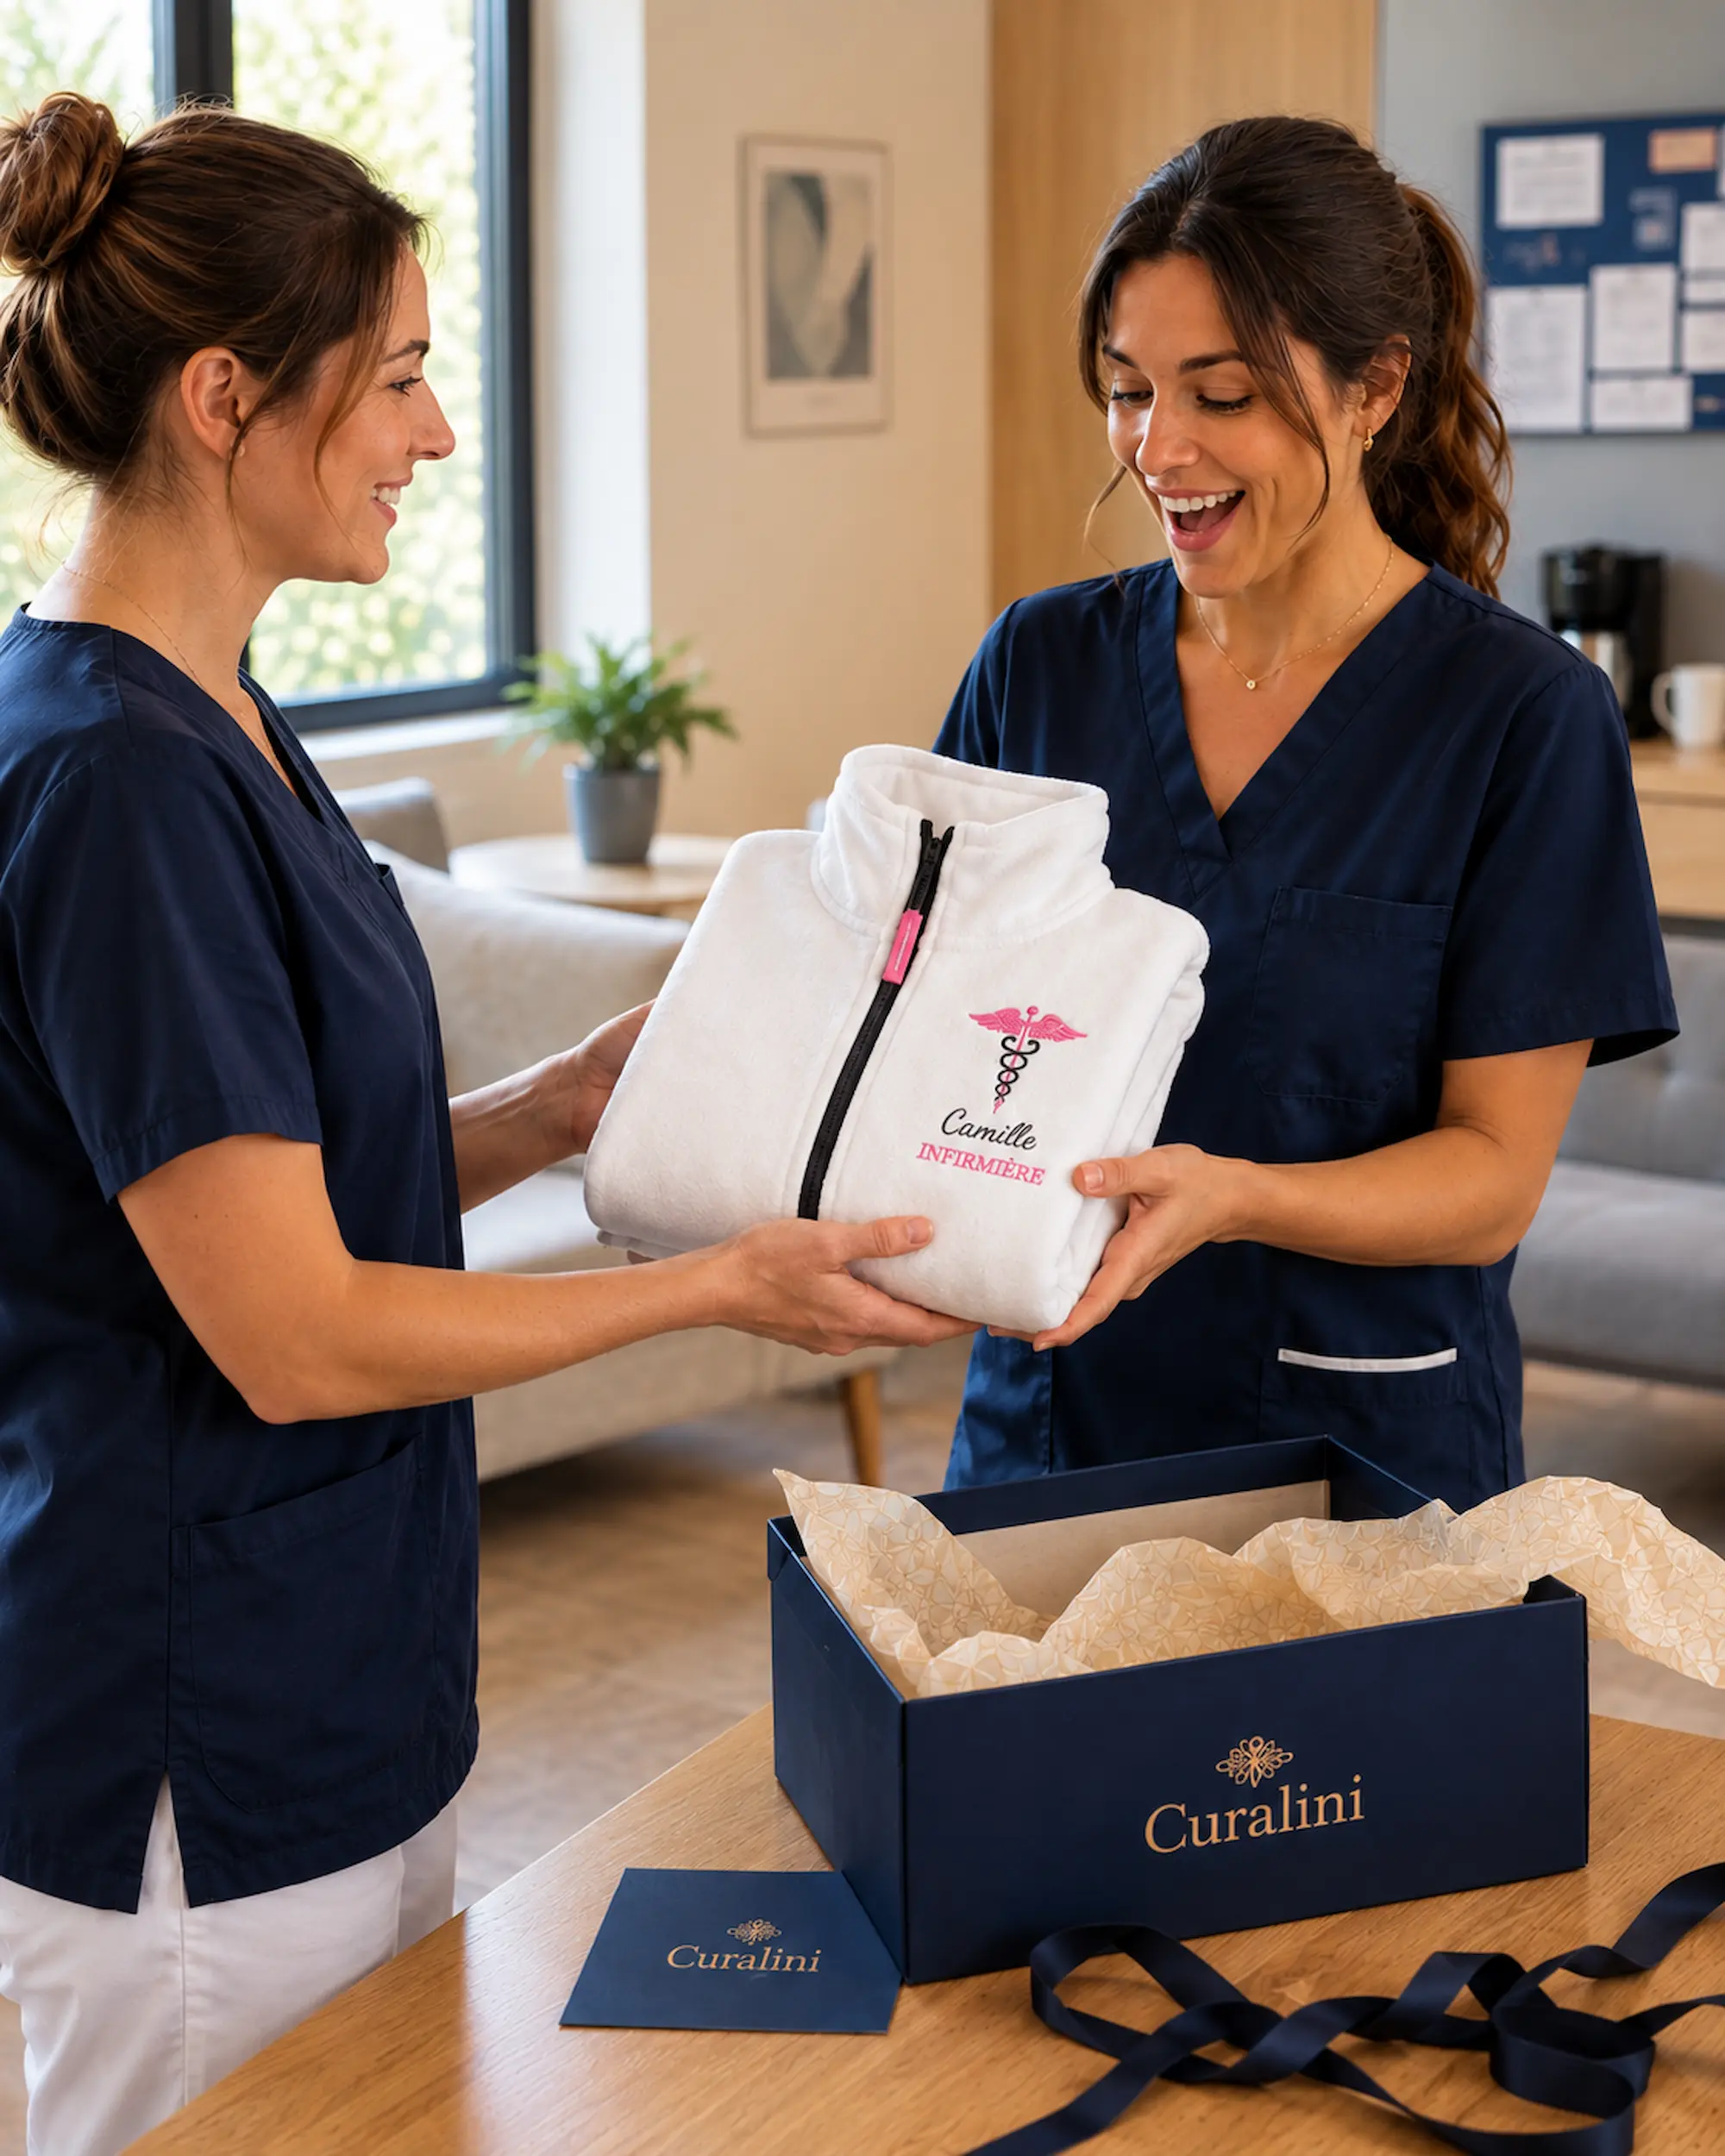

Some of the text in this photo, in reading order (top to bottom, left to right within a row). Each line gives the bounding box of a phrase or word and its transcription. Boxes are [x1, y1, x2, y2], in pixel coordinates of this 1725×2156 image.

[941, 1107, 1037, 1150] Camille
[916, 1142, 1045, 1185] INFIRMIÈRE
[1145, 1774, 1364, 1853] Curalini
[667, 1945, 821, 1972] Curalini
